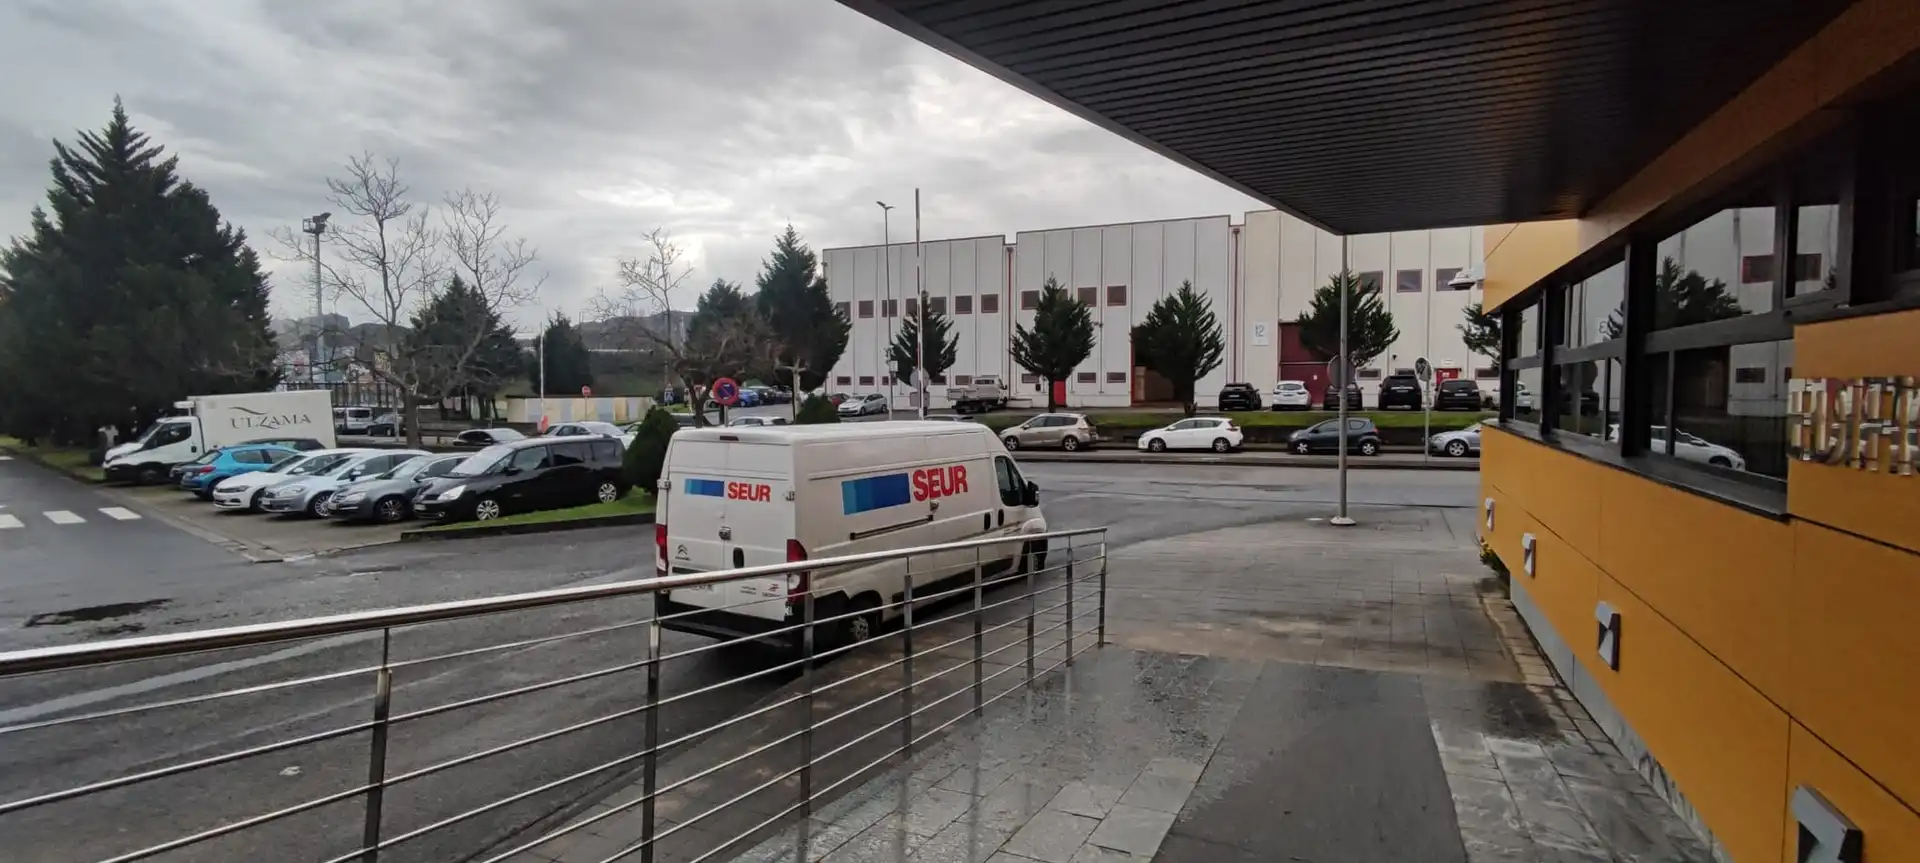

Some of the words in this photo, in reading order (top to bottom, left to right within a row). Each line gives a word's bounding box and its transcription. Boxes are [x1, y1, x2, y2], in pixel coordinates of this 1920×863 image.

[230, 413, 312, 429] ULZAMA
[727, 481, 771, 503] SEUR
[912, 465, 968, 502] SEUR
